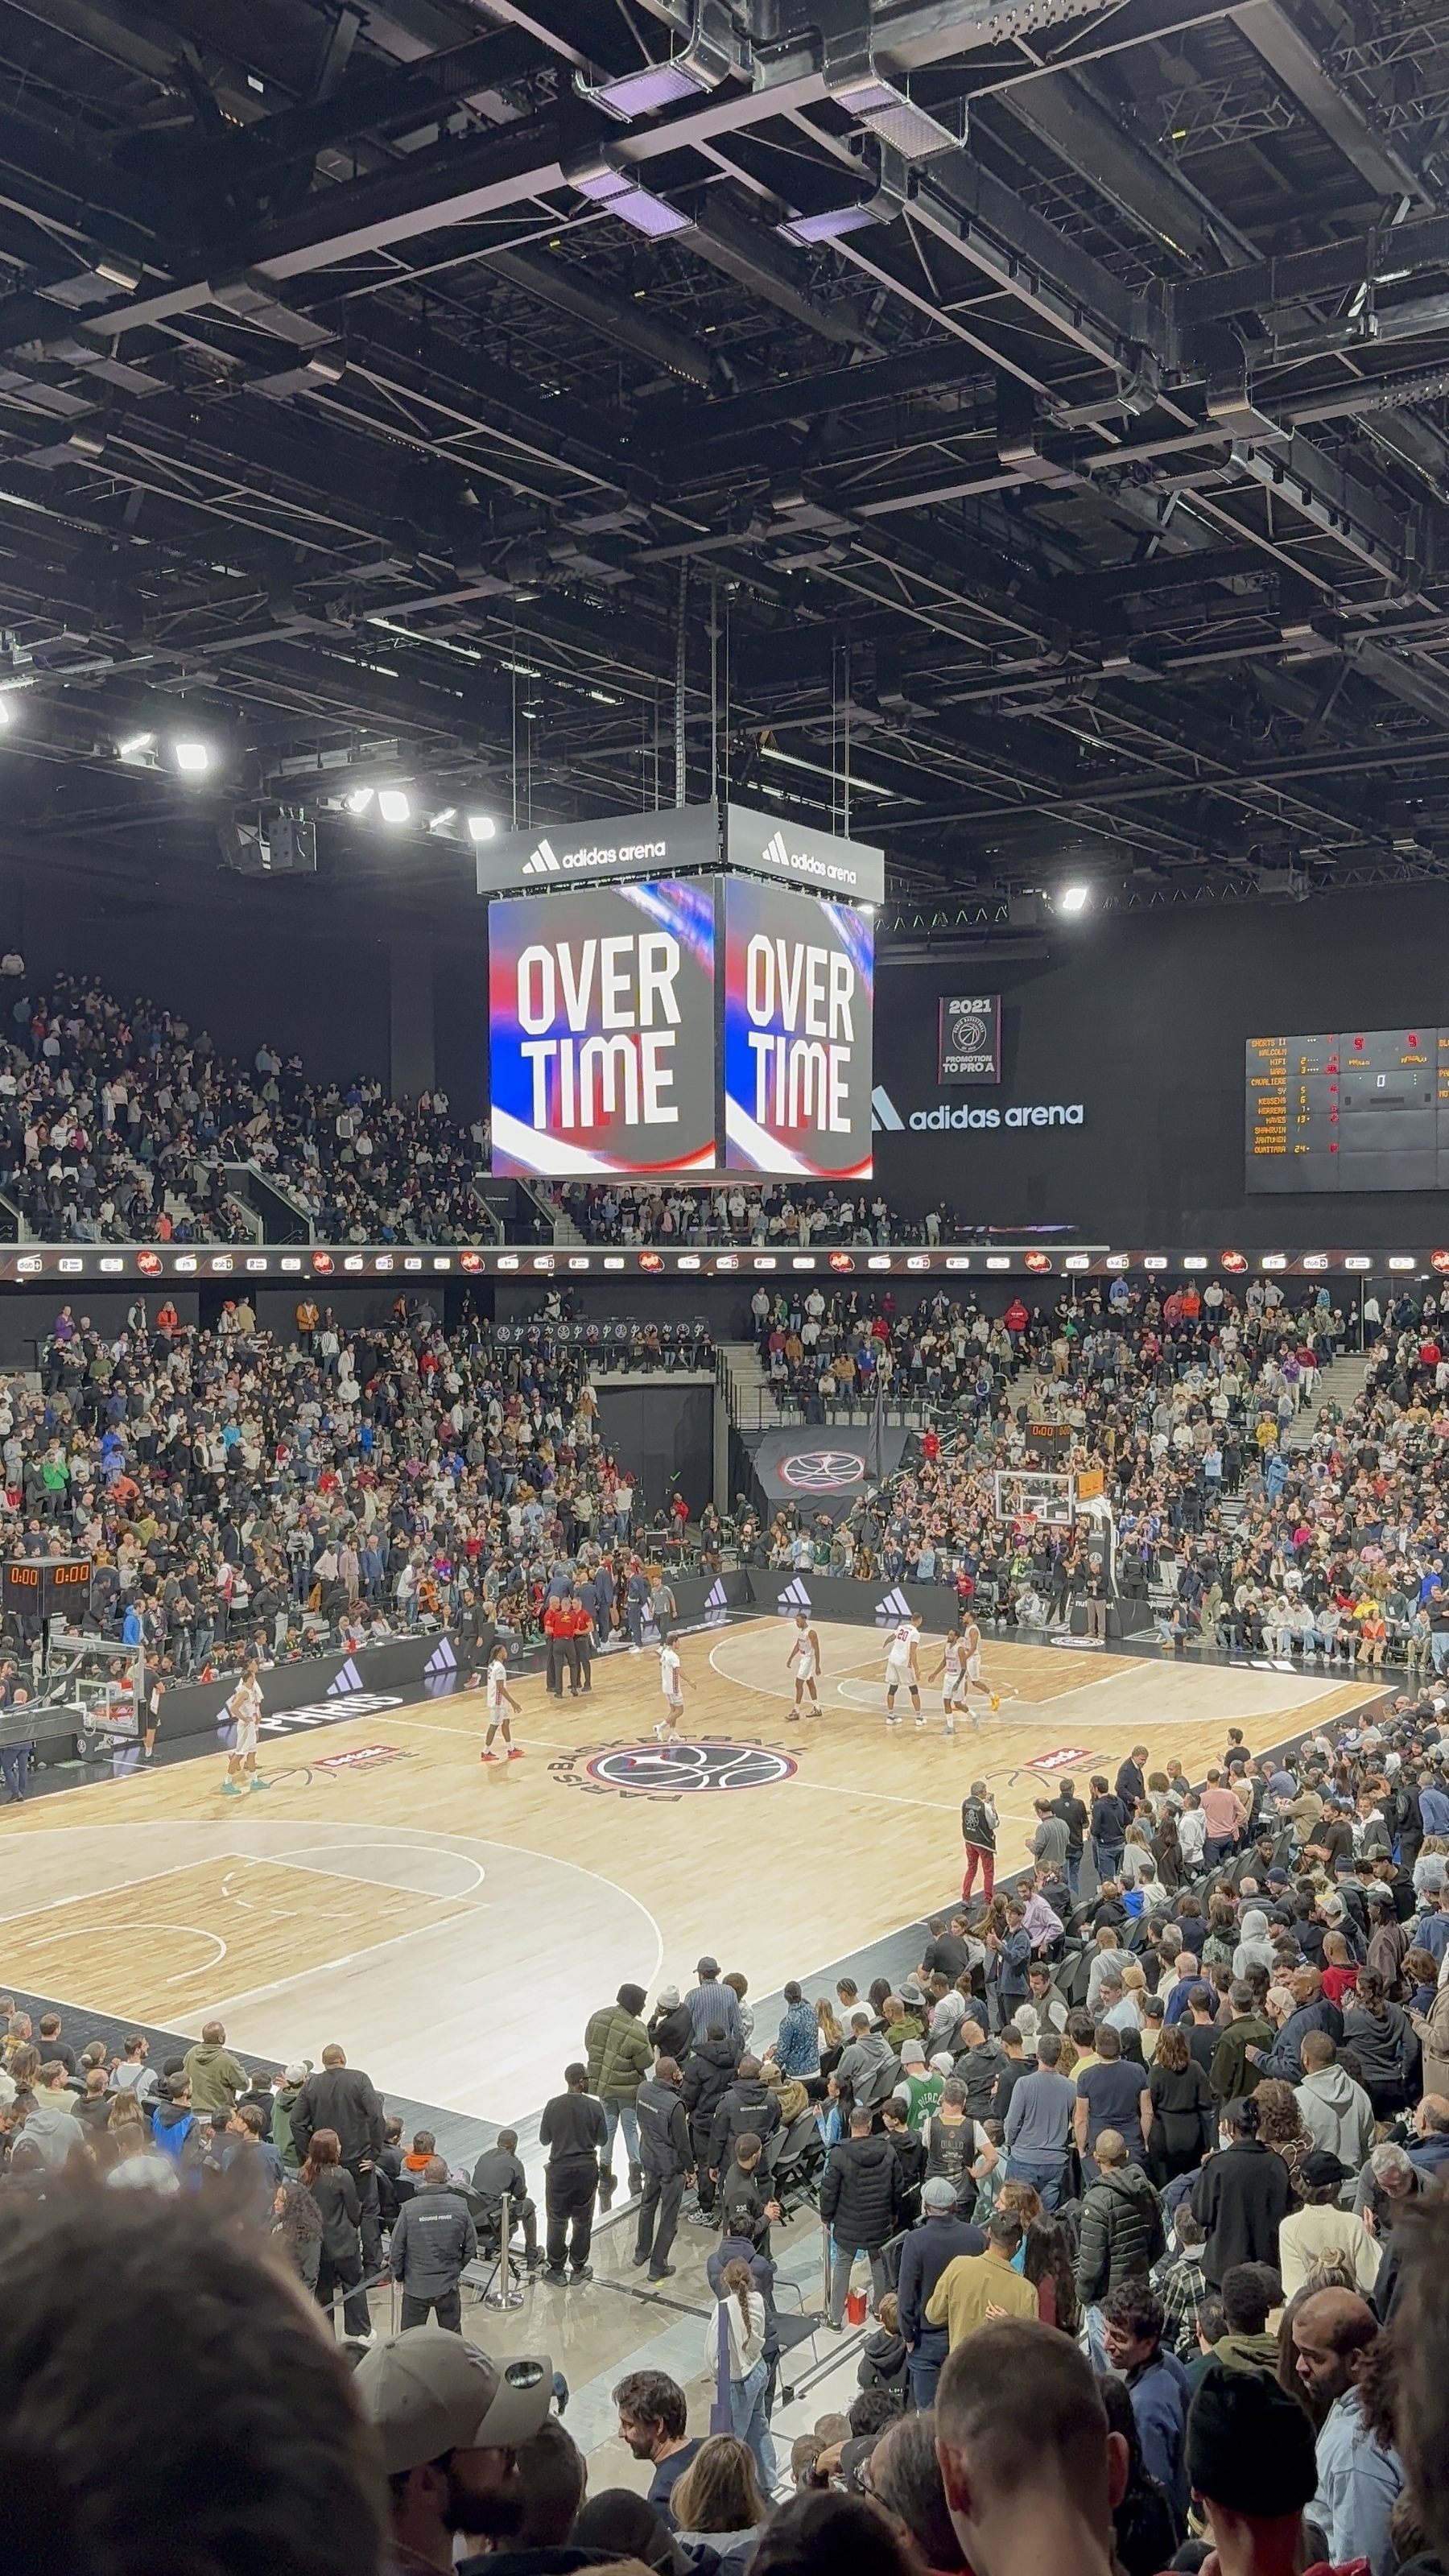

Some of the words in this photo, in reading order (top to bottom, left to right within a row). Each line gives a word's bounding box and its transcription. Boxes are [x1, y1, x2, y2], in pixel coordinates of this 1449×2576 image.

[563, 846, 616, 869] adidas
[618, 840, 666, 864] arena
[791, 853, 826, 877] adidas
[827, 863, 857, 885] arena
[518, 931, 681, 1035] OVER
[747, 934, 854, 1042] OVER
[948, 999, 992, 1013] 2021
[943, 1063, 959, 1073] TO
[960, 1063, 984, 1072] PRO
[985, 1063, 995, 1072] A
[945, 1055, 993, 1063] PROMOTION
[521, 1030, 679, 1129] TIME
[748, 1031, 852, 1133] TIME
[909, 1104, 1000, 1131] adidas
[1005, 1104, 1084, 1127] arena
[11, 1567, 38, 1585] 0:00
[56, 1565, 89, 1583] 0:00
[898, 1629, 909, 1642] 20
[258, 1693, 403, 1732] PARIS
[917, 2092, 942, 2108] PIERCE
